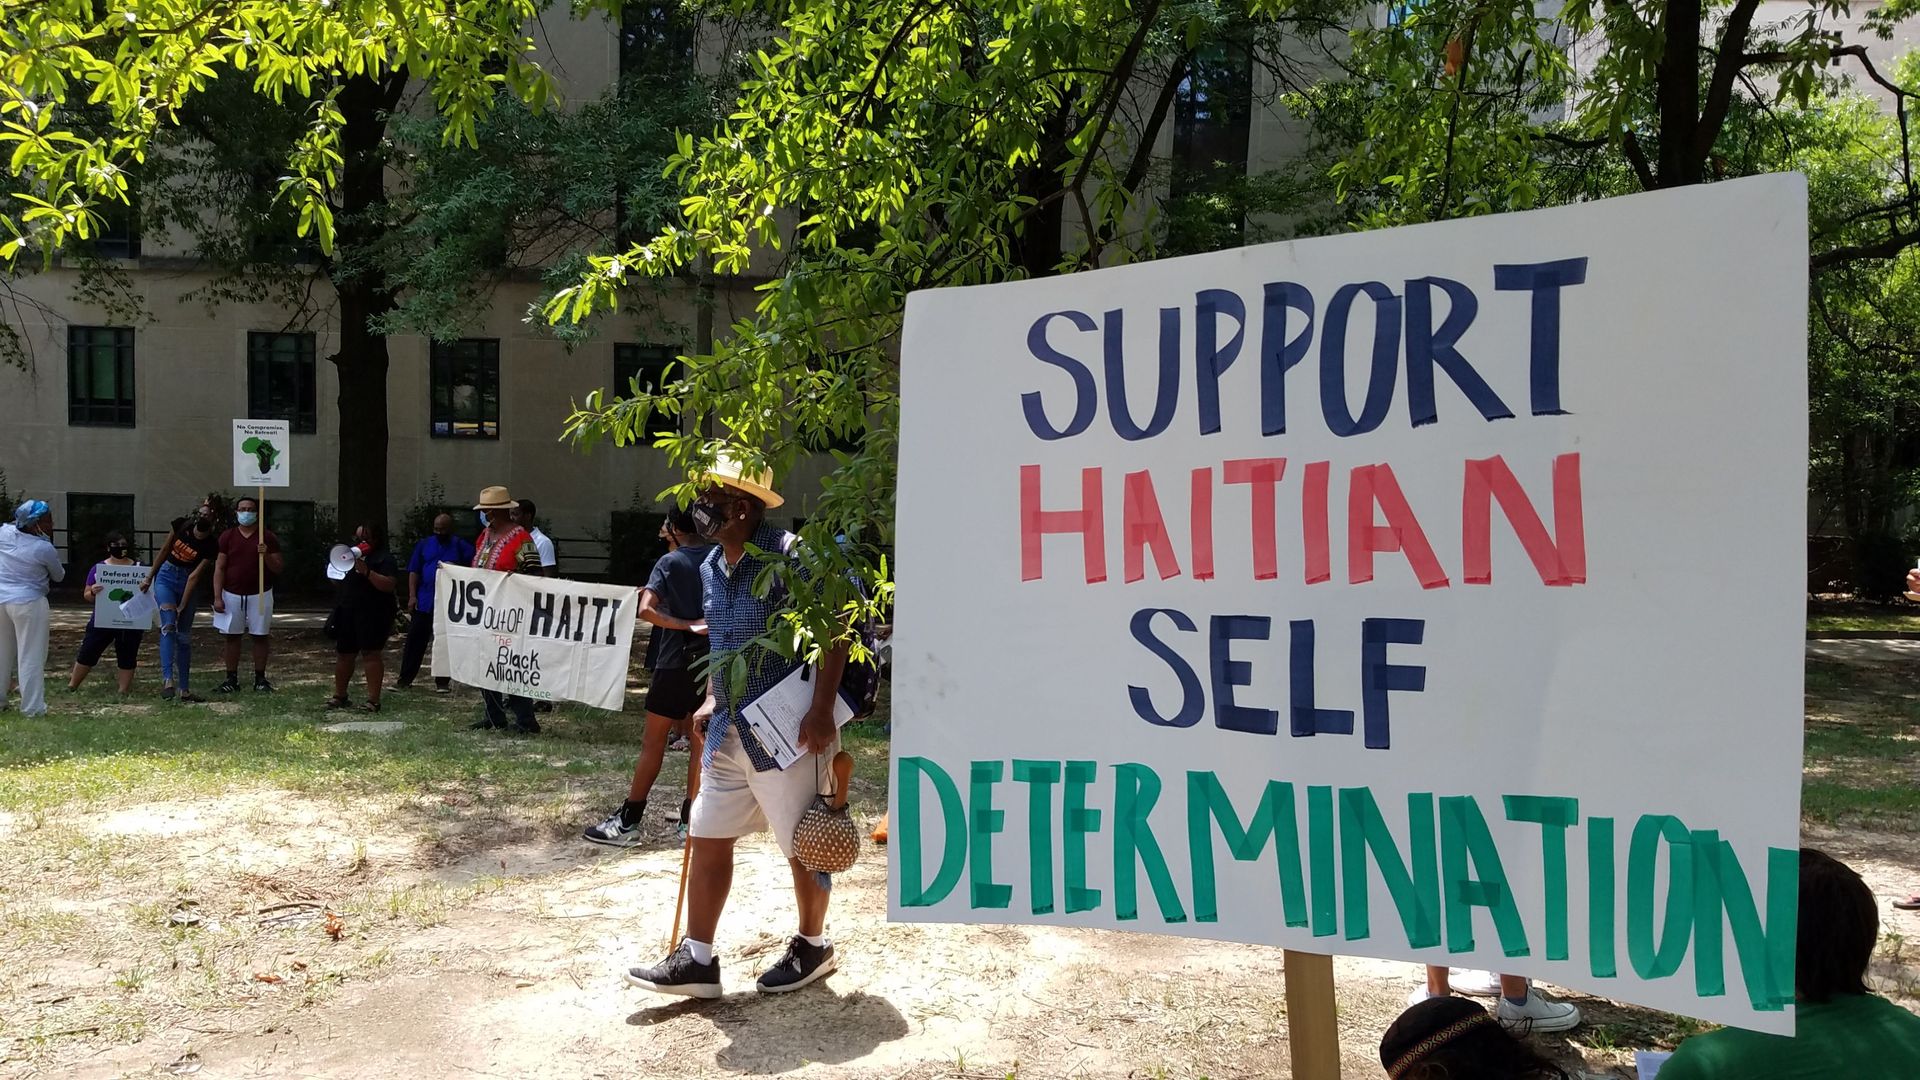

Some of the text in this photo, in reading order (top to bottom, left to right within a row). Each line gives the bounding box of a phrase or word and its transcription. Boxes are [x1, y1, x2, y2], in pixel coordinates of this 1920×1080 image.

[1020, 256, 1590, 442] SUPPORT
[1019, 452, 1587, 590] HAITIAN
[448, 579, 486, 626] US
[529, 592, 623, 645] HAITI
[492, 634, 512, 646] The
[485, 661, 541, 687] Alliance
[497, 645, 540, 671] Black
[1127, 608, 1427, 750] SELF
[522, 685, 551, 698] Peace
[897, 756, 1799, 1012] DETERMINATION
